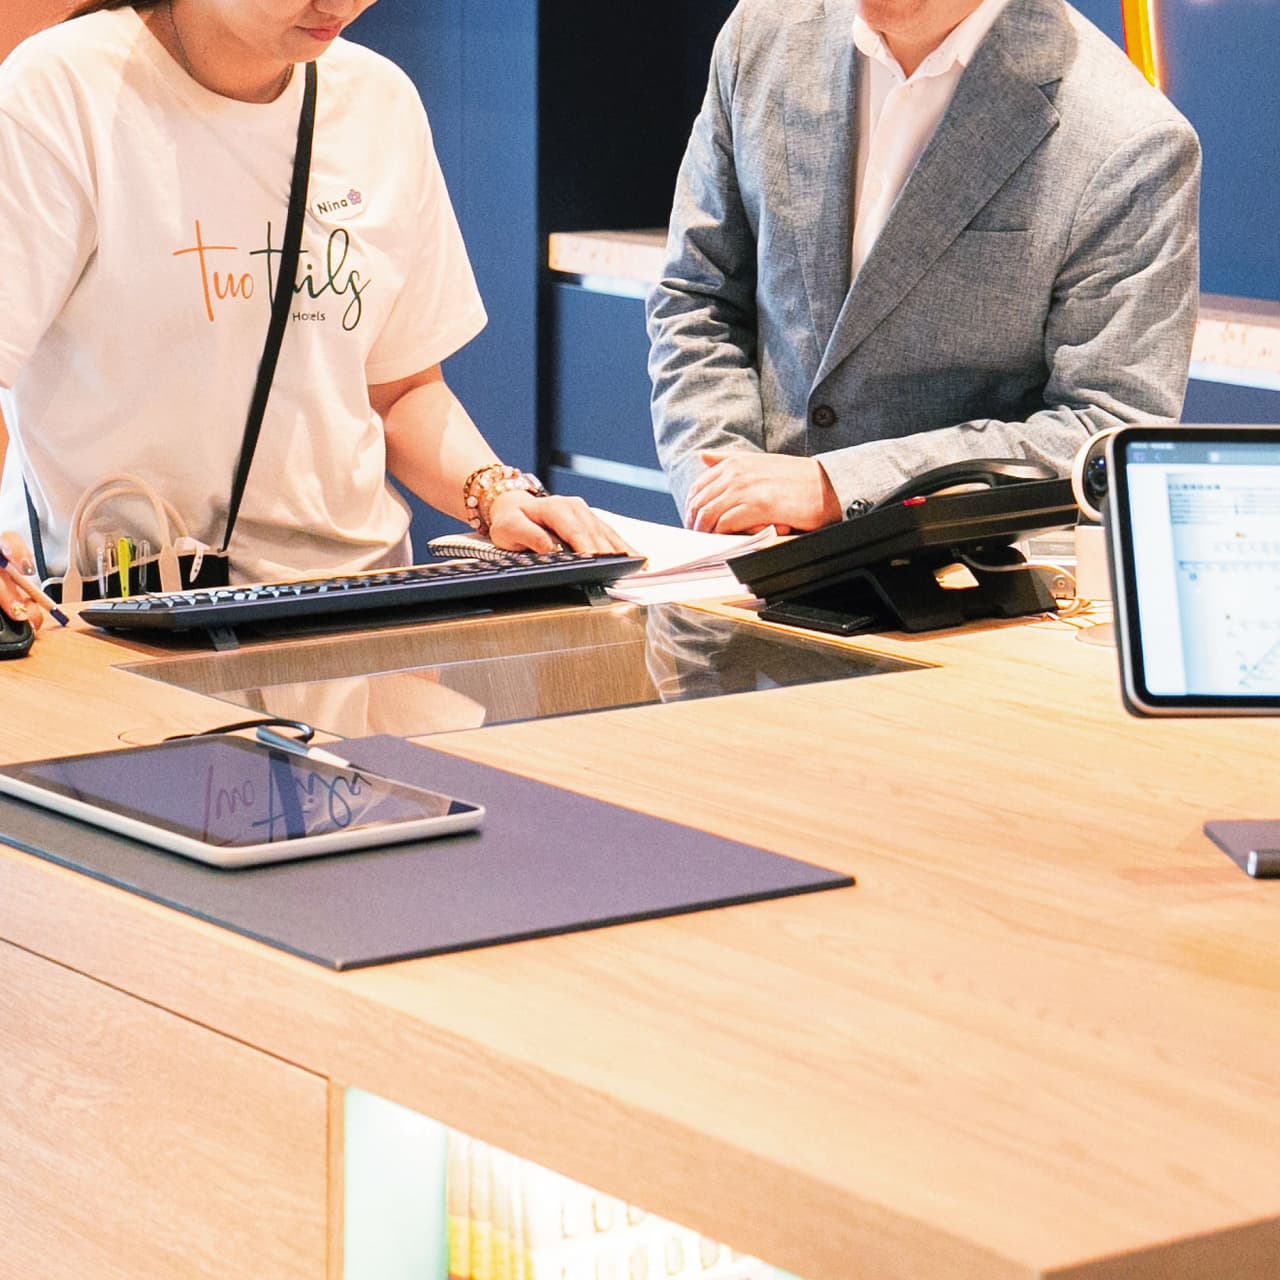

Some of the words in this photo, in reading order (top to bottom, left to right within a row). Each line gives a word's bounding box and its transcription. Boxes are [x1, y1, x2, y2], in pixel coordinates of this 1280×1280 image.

[317, 198, 348, 215] Nina
[172, 219, 254, 322] two
[249, 220, 372, 332] tils
[291, 311, 326, 322] Hotels
